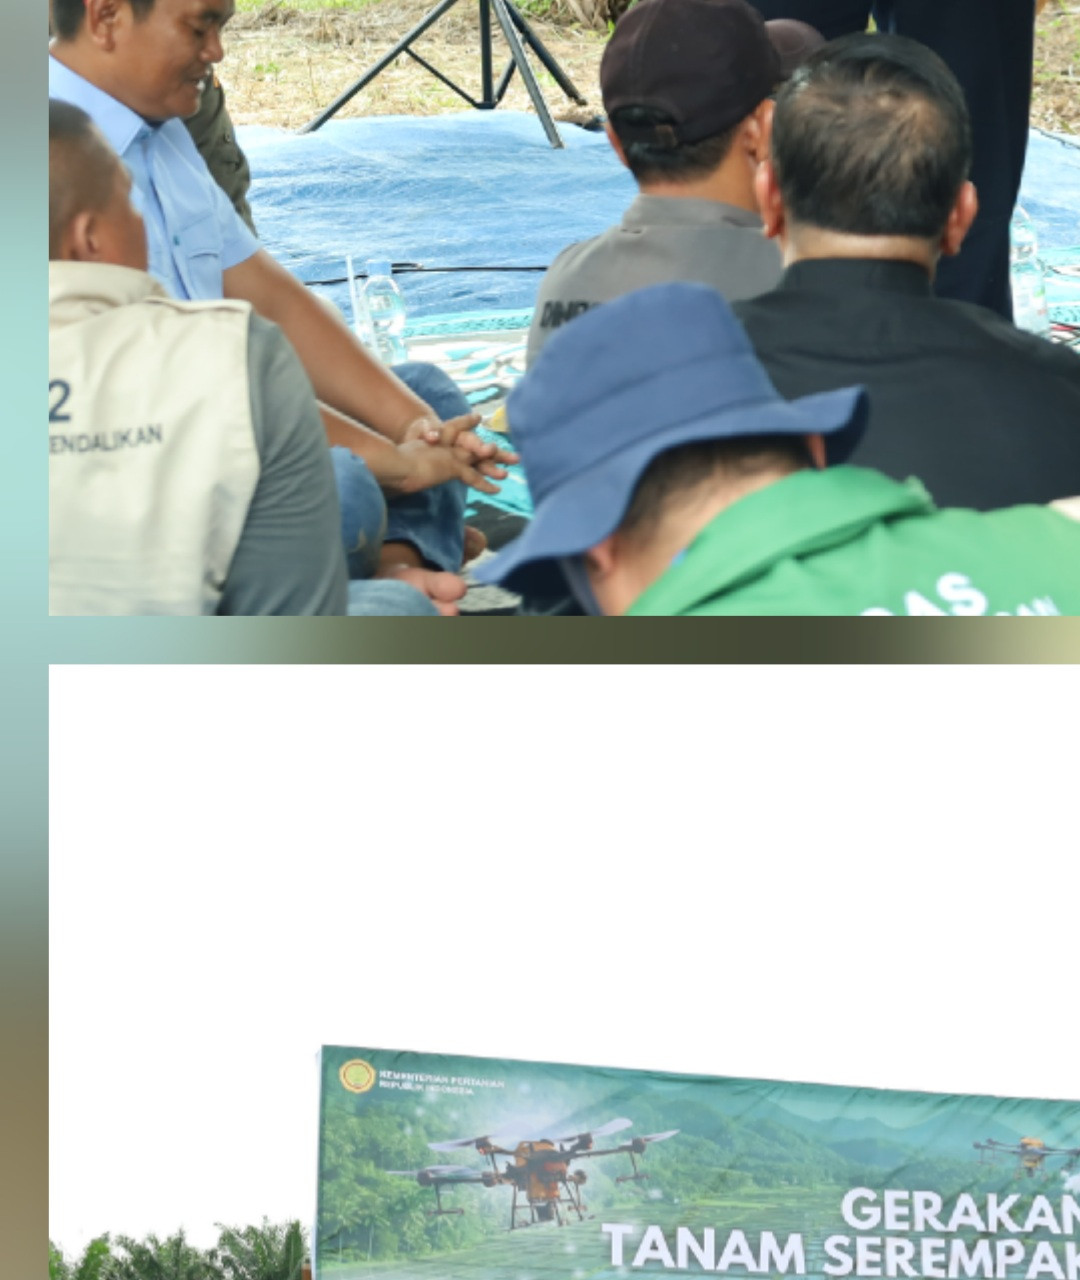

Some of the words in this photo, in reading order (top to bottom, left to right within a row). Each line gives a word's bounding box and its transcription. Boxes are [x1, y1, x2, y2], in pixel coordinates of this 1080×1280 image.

[379, 1070, 448, 1084] KEMENTERIAN
[450, 1075, 505, 1088] PERTANIAN
[379, 1080, 424, 1091] REPUBLIK
[602, 1222, 806, 1276] TANAM
